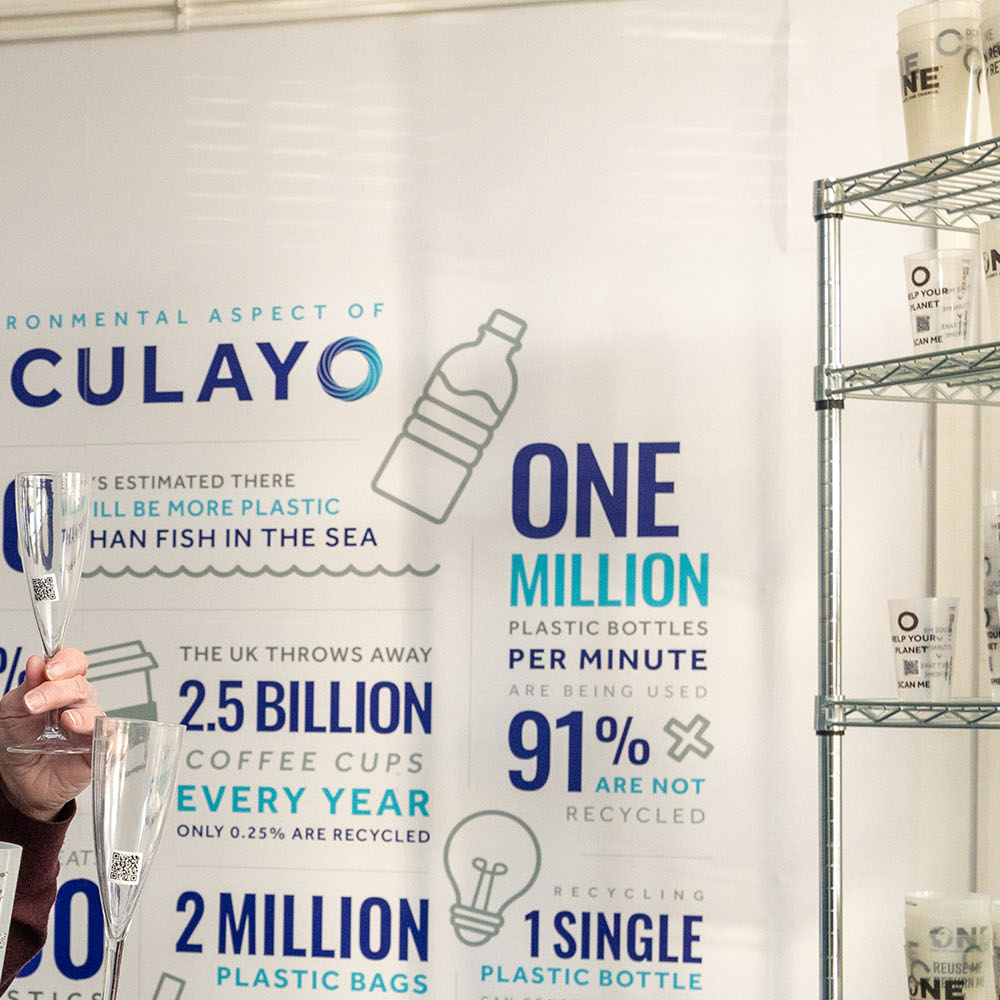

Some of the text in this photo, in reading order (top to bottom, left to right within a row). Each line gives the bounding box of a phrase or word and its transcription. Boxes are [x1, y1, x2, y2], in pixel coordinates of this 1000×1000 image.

[921, 287, 949, 298] YOUR
[208, 304, 327, 324] ASPECT
[347, 302, 384, 319] OF
[930, 335, 943, 343] ME
[114, 473, 295, 491] ESTIMATED THERE
[511, 441, 681, 540] ONE
[133, 497, 340, 518] BE MORE PLASTIC
[156, 527, 378, 549] FISH IN THE SEA
[510, 552, 709, 608] MILLION
[509, 620, 708, 636] PLASTIC BOTTLES
[908, 633, 936, 643] YOUR
[179, 645, 433, 663] THE UK THROWS AWAY
[509, 648, 708, 671] PER MINUTE
[508, 683, 708, 699] ARE BEING USED
[917, 680, 931, 689] ME
[179, 679, 433, 735] 2.5 BILLION
[185, 748, 424, 775] COFFEE CUPS
[507, 709, 651, 794] 91%
[595, 776, 705, 795] ARE NOT
[177, 784, 430, 818] EVERY YEAR
[566, 805, 705, 824] RECYCLED
[176, 824, 431, 844] ONLY 0.25% ARE RECYCLED
[553, 885, 704, 901] RECYCLING
[175, 890, 430, 963] 2 MILLION
[524, 909, 703, 964] 1 SINGLE
[217, 966, 428, 995] PLASTIC BAGS
[481, 965, 702, 991] PLASTIC BOTTLE
